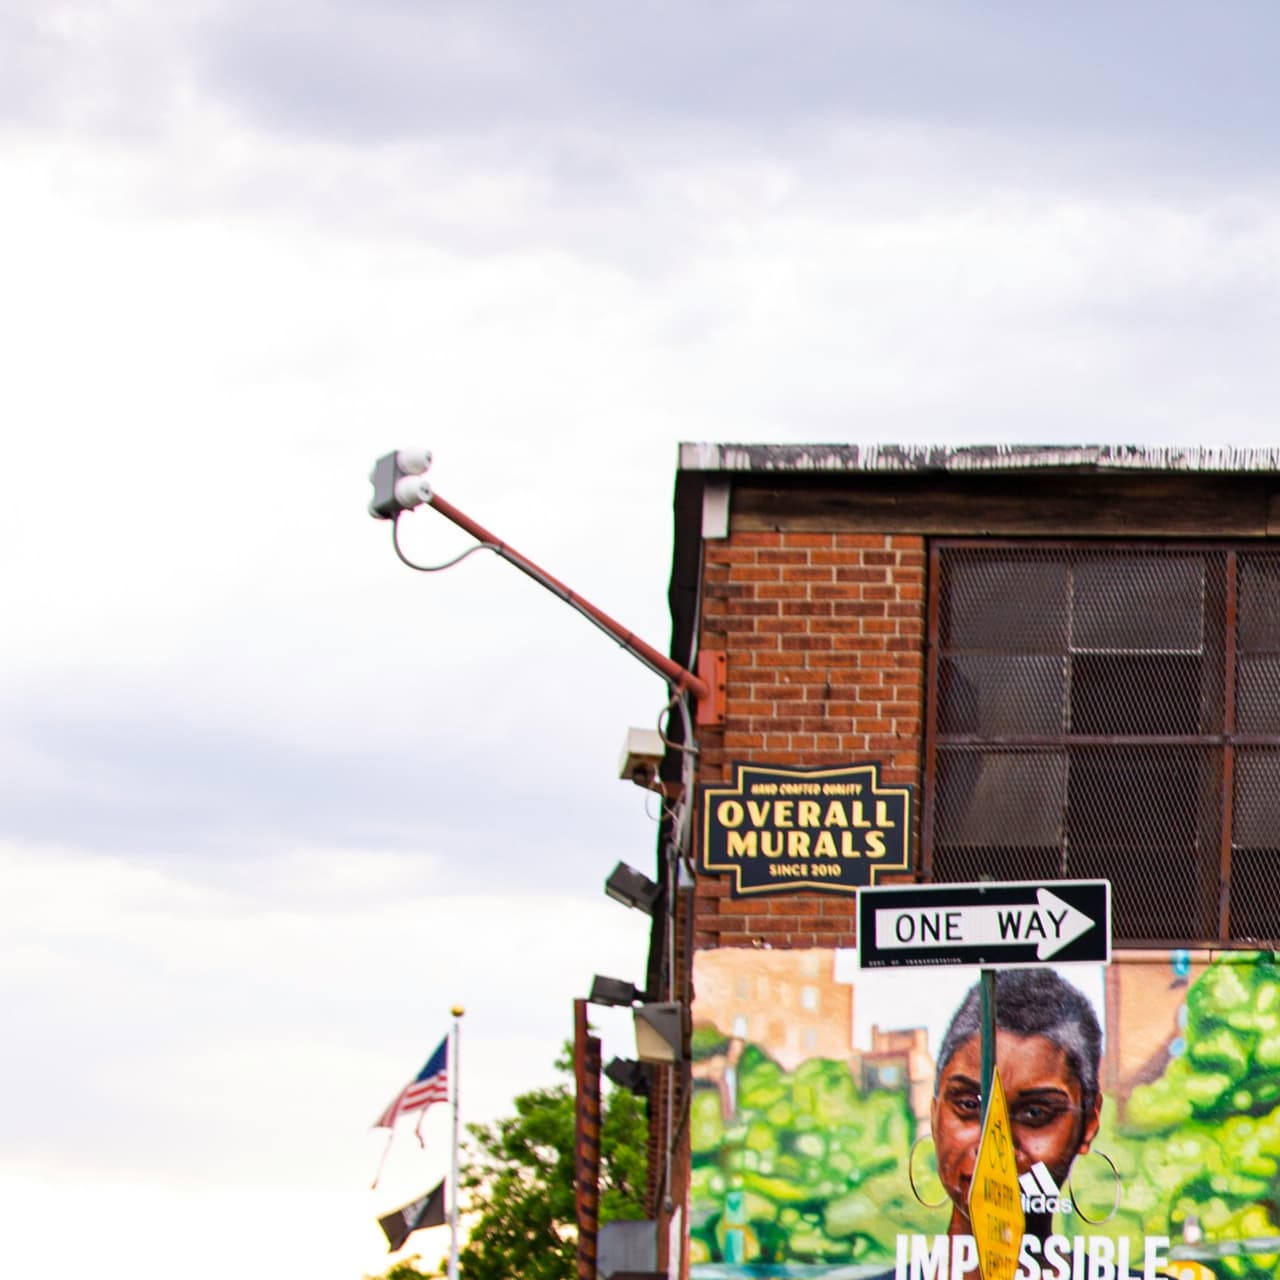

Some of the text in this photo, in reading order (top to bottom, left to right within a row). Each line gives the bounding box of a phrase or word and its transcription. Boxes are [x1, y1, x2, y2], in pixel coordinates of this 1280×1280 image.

[717, 800, 895, 828] OVERALL
[727, 830, 887, 858] MURALS
[769, 864, 841, 877] SINCE 2010
[896, 909, 1068, 942] ONE WAY
